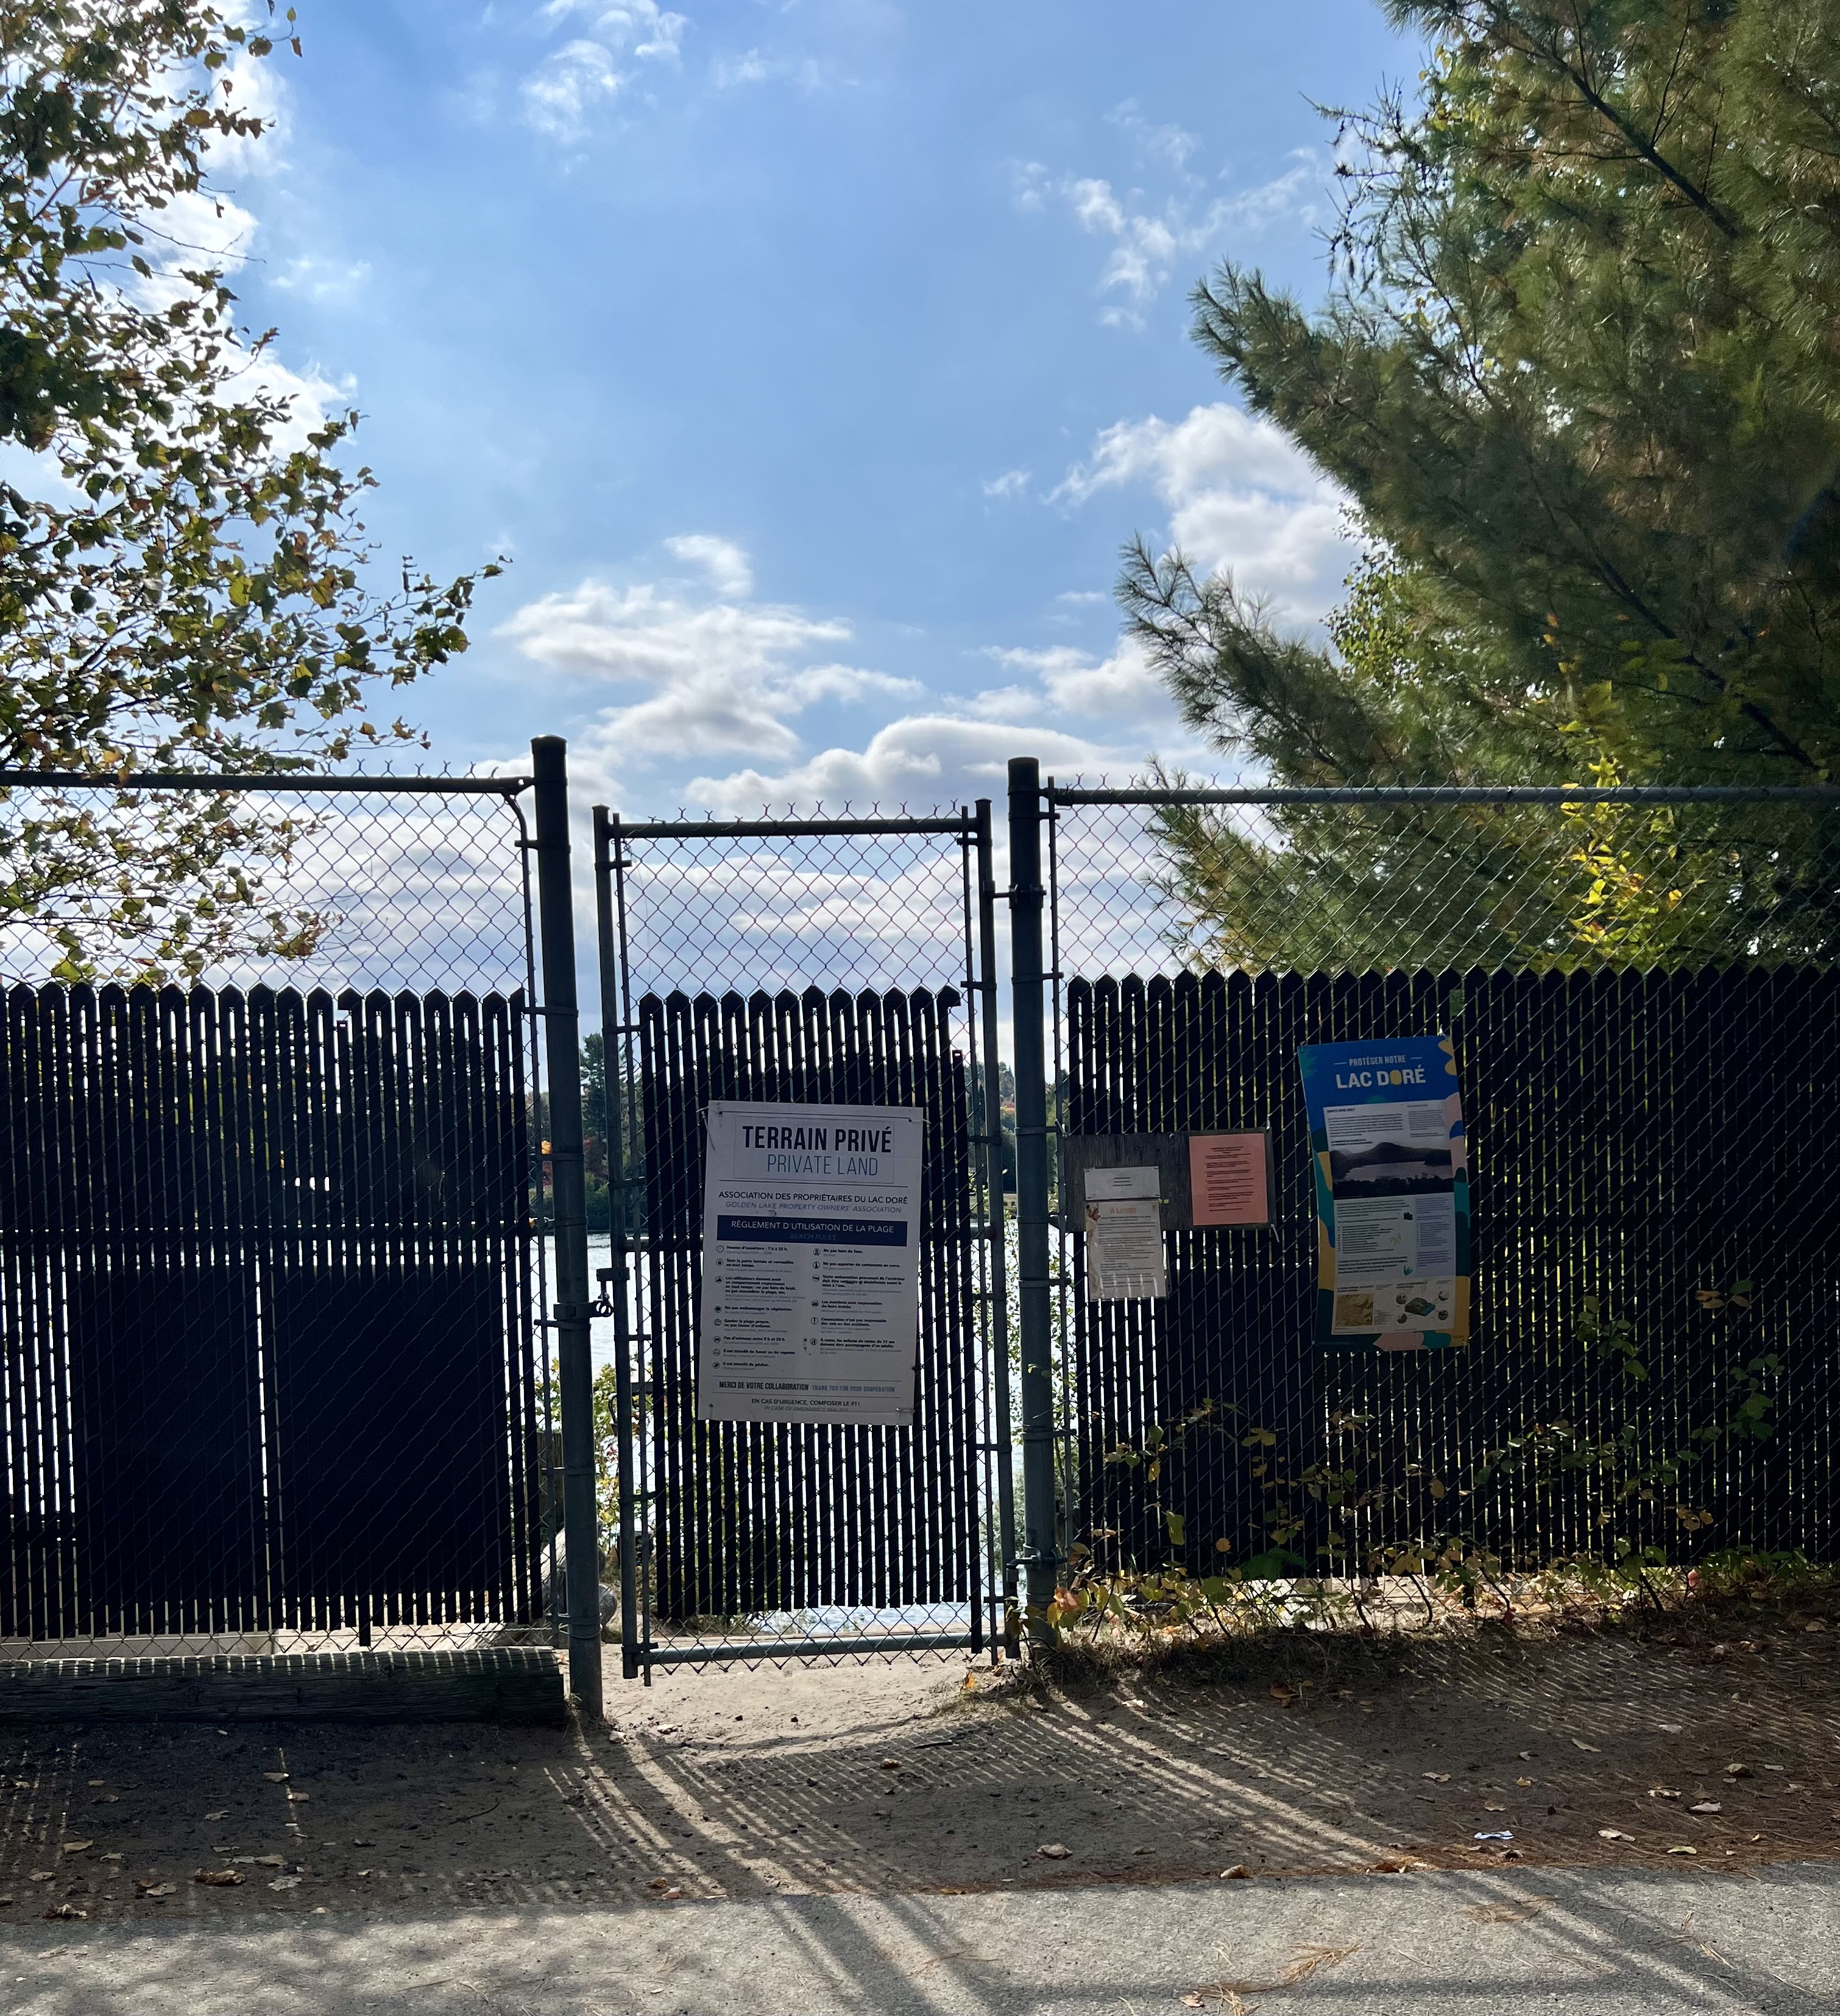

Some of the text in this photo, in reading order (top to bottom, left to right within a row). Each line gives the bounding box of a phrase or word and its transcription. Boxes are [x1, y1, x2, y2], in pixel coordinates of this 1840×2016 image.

[1349, 1055, 1406, 1066] PROTÉGER NOTRE
[1336, 1064, 1426, 1089] LAC DORÉ
[743, 1126, 891, 1153] TERRAIN PRIVÉ
[768, 1155, 877, 1176] PRIVATE LAND
[793, 1194, 852, 1202] PROPRIÉTAIRES
[731, 1219, 780, 1229] RÈGLEMENT
[784, 1222, 840, 1231] D'UTILISATION
